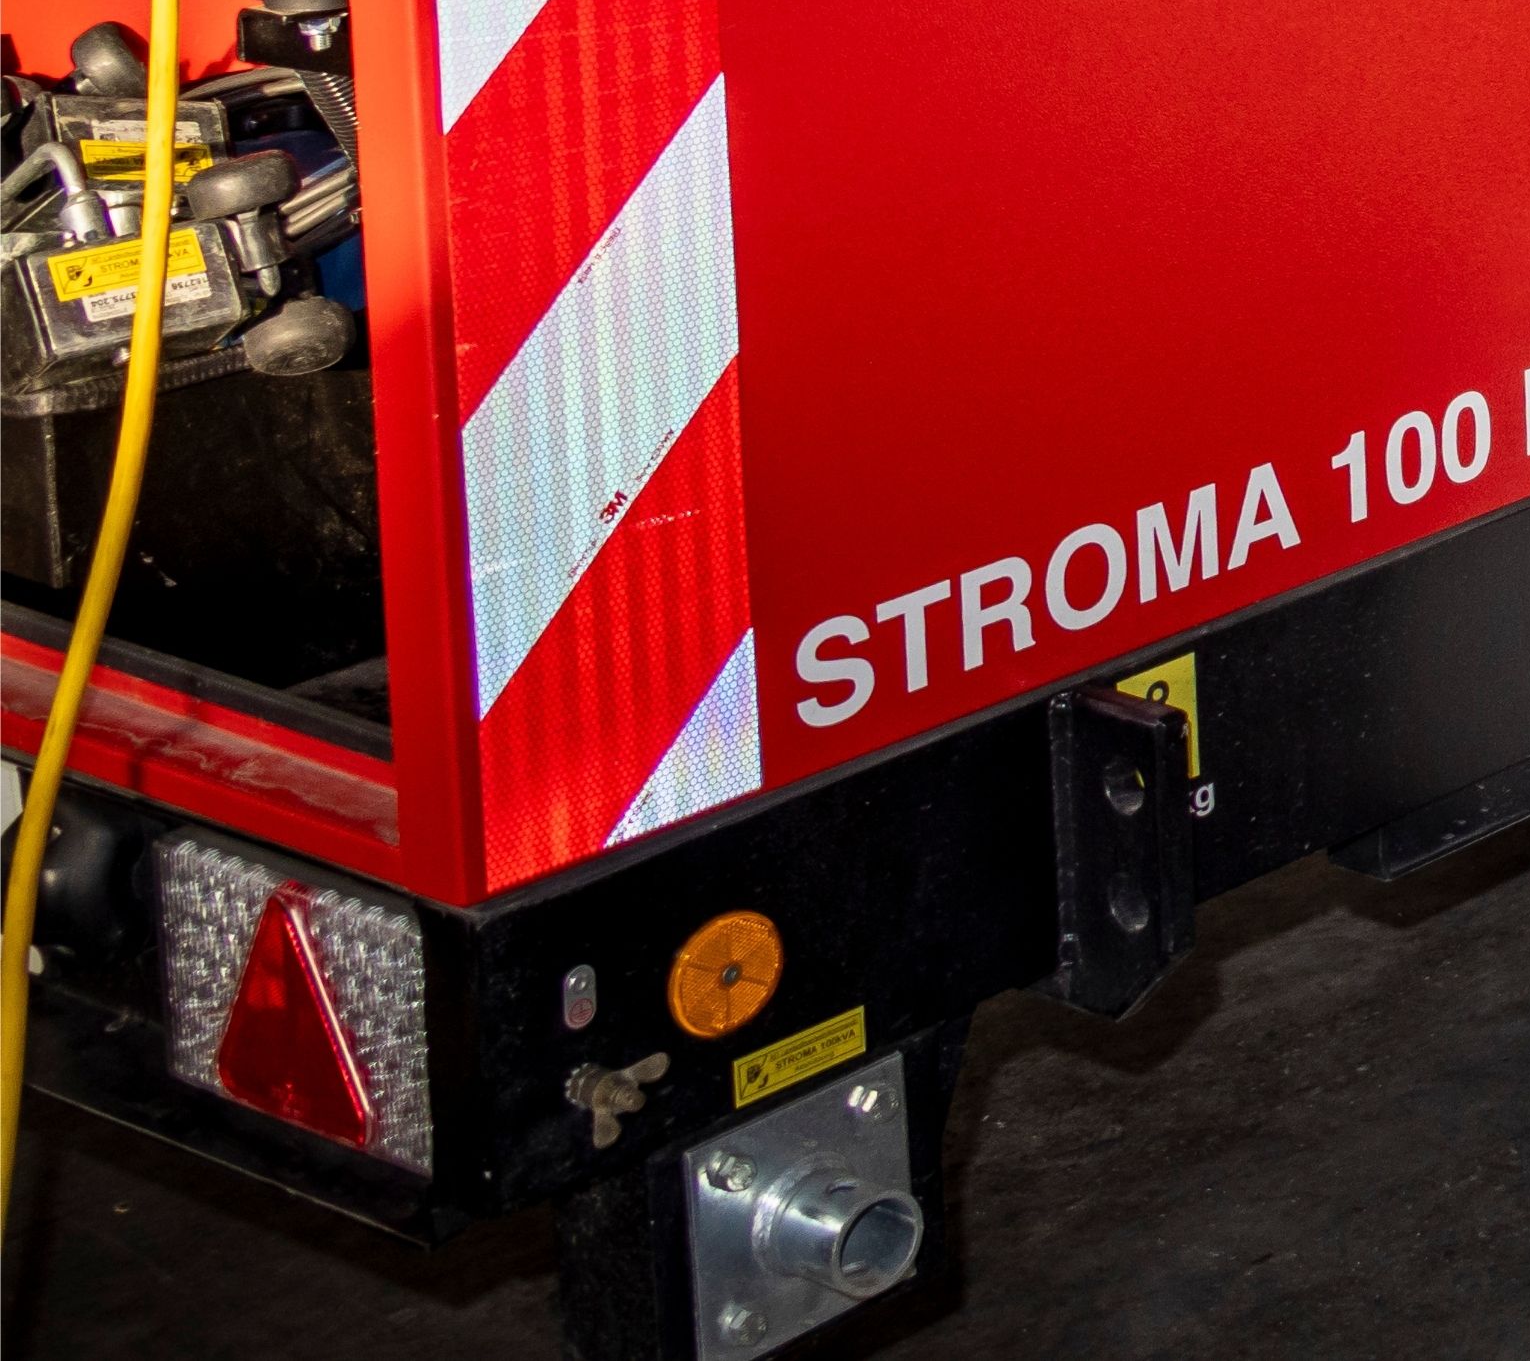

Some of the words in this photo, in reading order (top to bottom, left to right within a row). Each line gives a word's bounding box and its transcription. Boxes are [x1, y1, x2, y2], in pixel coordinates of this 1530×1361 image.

[100, 258, 141, 274] STROM
[796, 461, 1302, 729] STROMA
[1331, 390, 1492, 523] 100
[775, 1045, 817, 1070] STROMA
